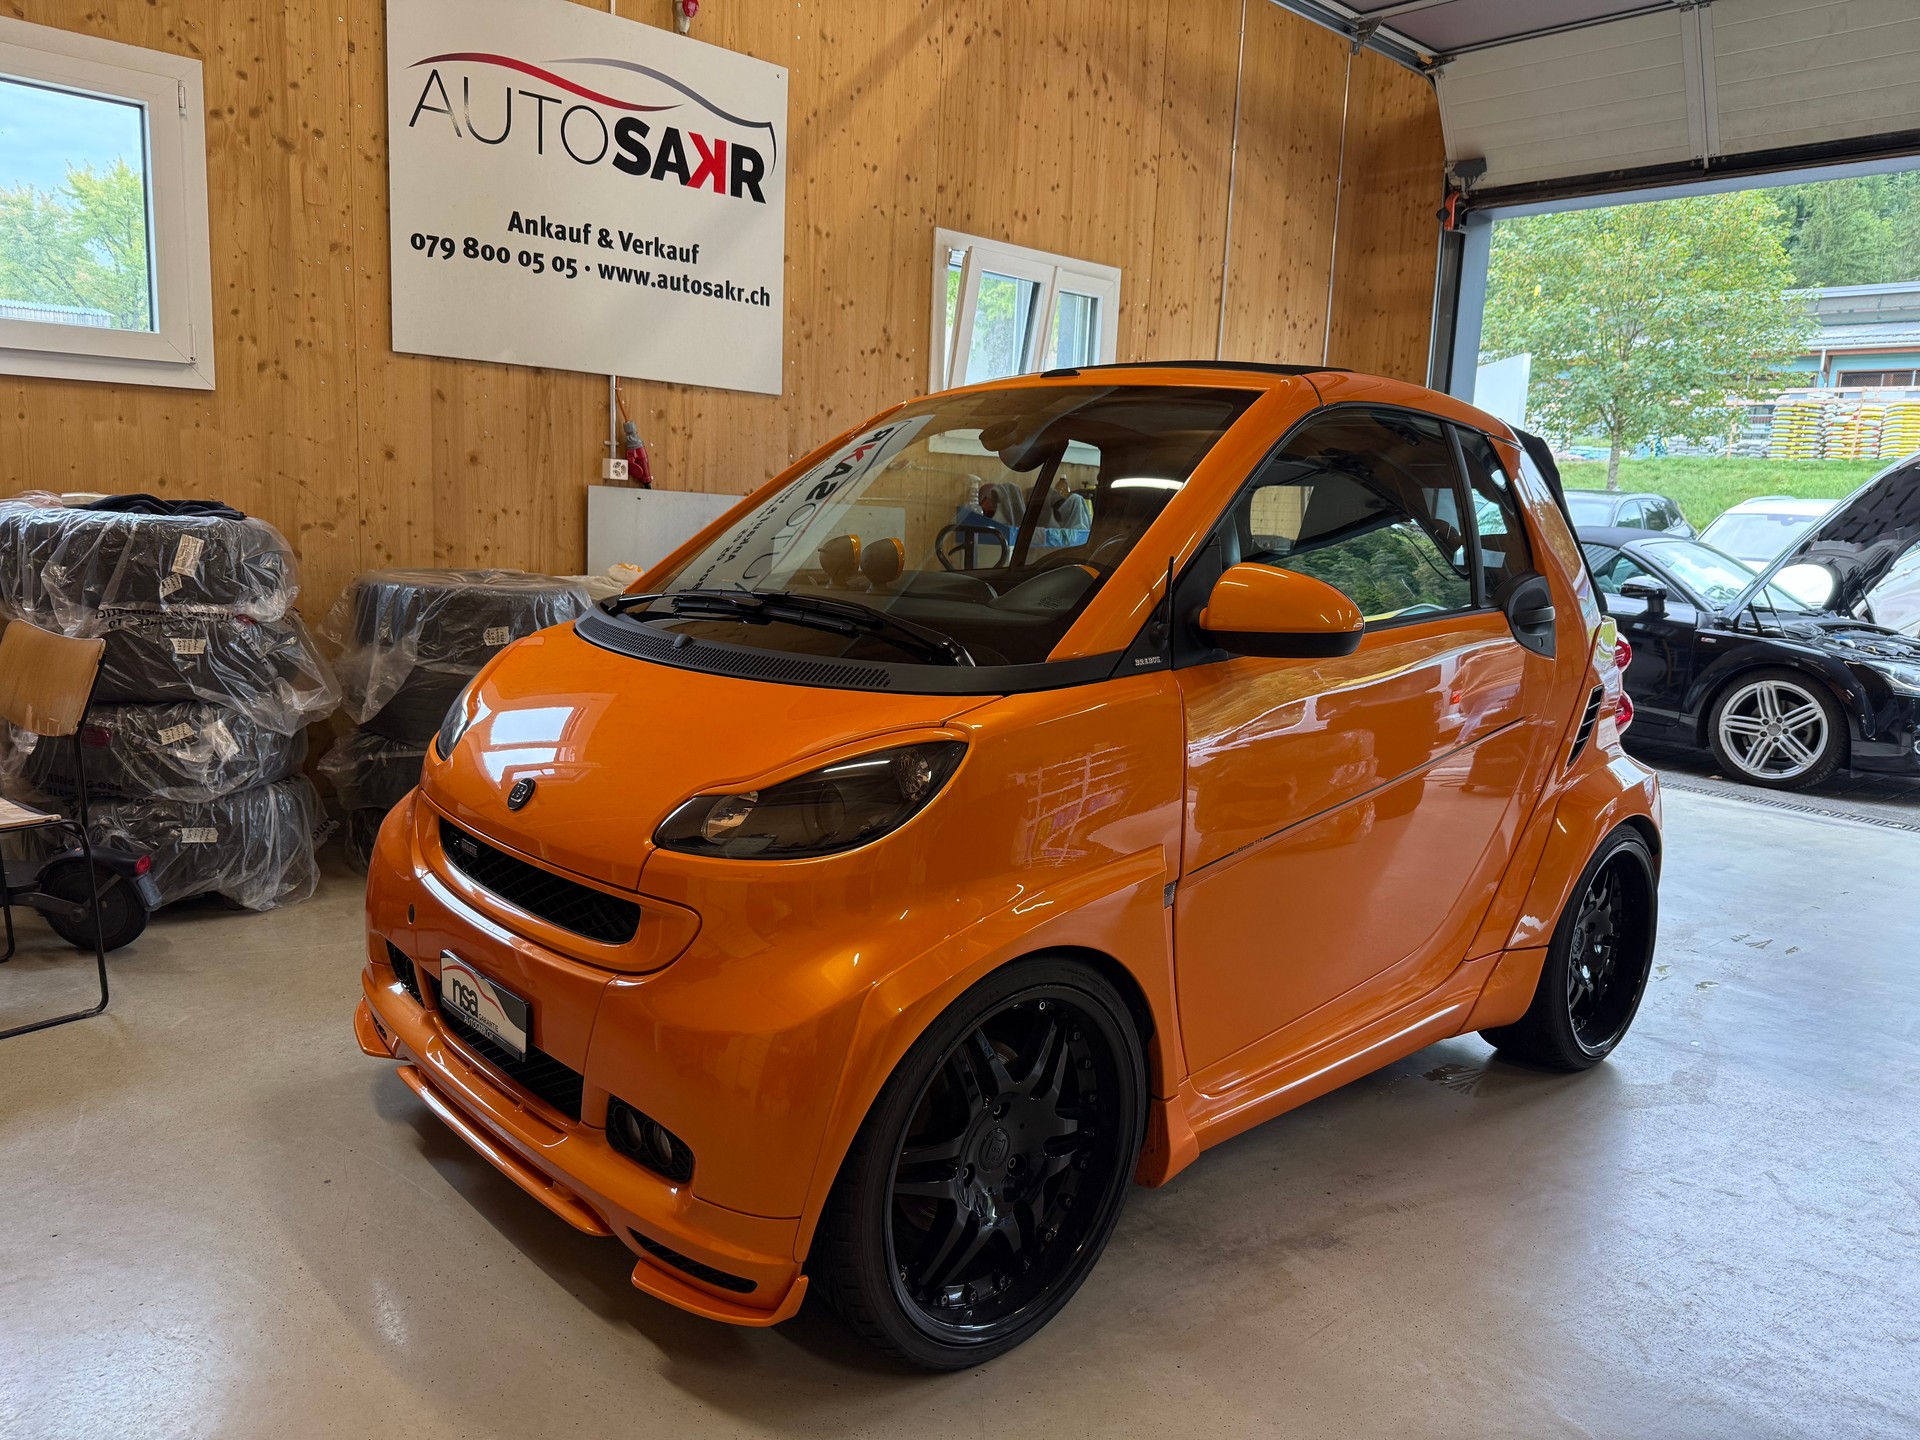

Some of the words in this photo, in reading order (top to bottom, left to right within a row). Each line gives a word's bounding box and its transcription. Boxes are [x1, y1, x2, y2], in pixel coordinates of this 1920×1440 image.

[408, 69, 767, 204] AUTOSAKR
[410, 232, 456, 261] 079
[462, 236, 511, 264] 800
[517, 250, 545, 275] 05
[551, 255, 578, 280] 05
[597, 262, 771, 308] www.autosakr.ch
[507, 210, 592, 246] Ankauf
[597, 227, 615, 250] &
[617, 229, 700, 265] Verkauf
[452, 977, 479, 1019] nsa
